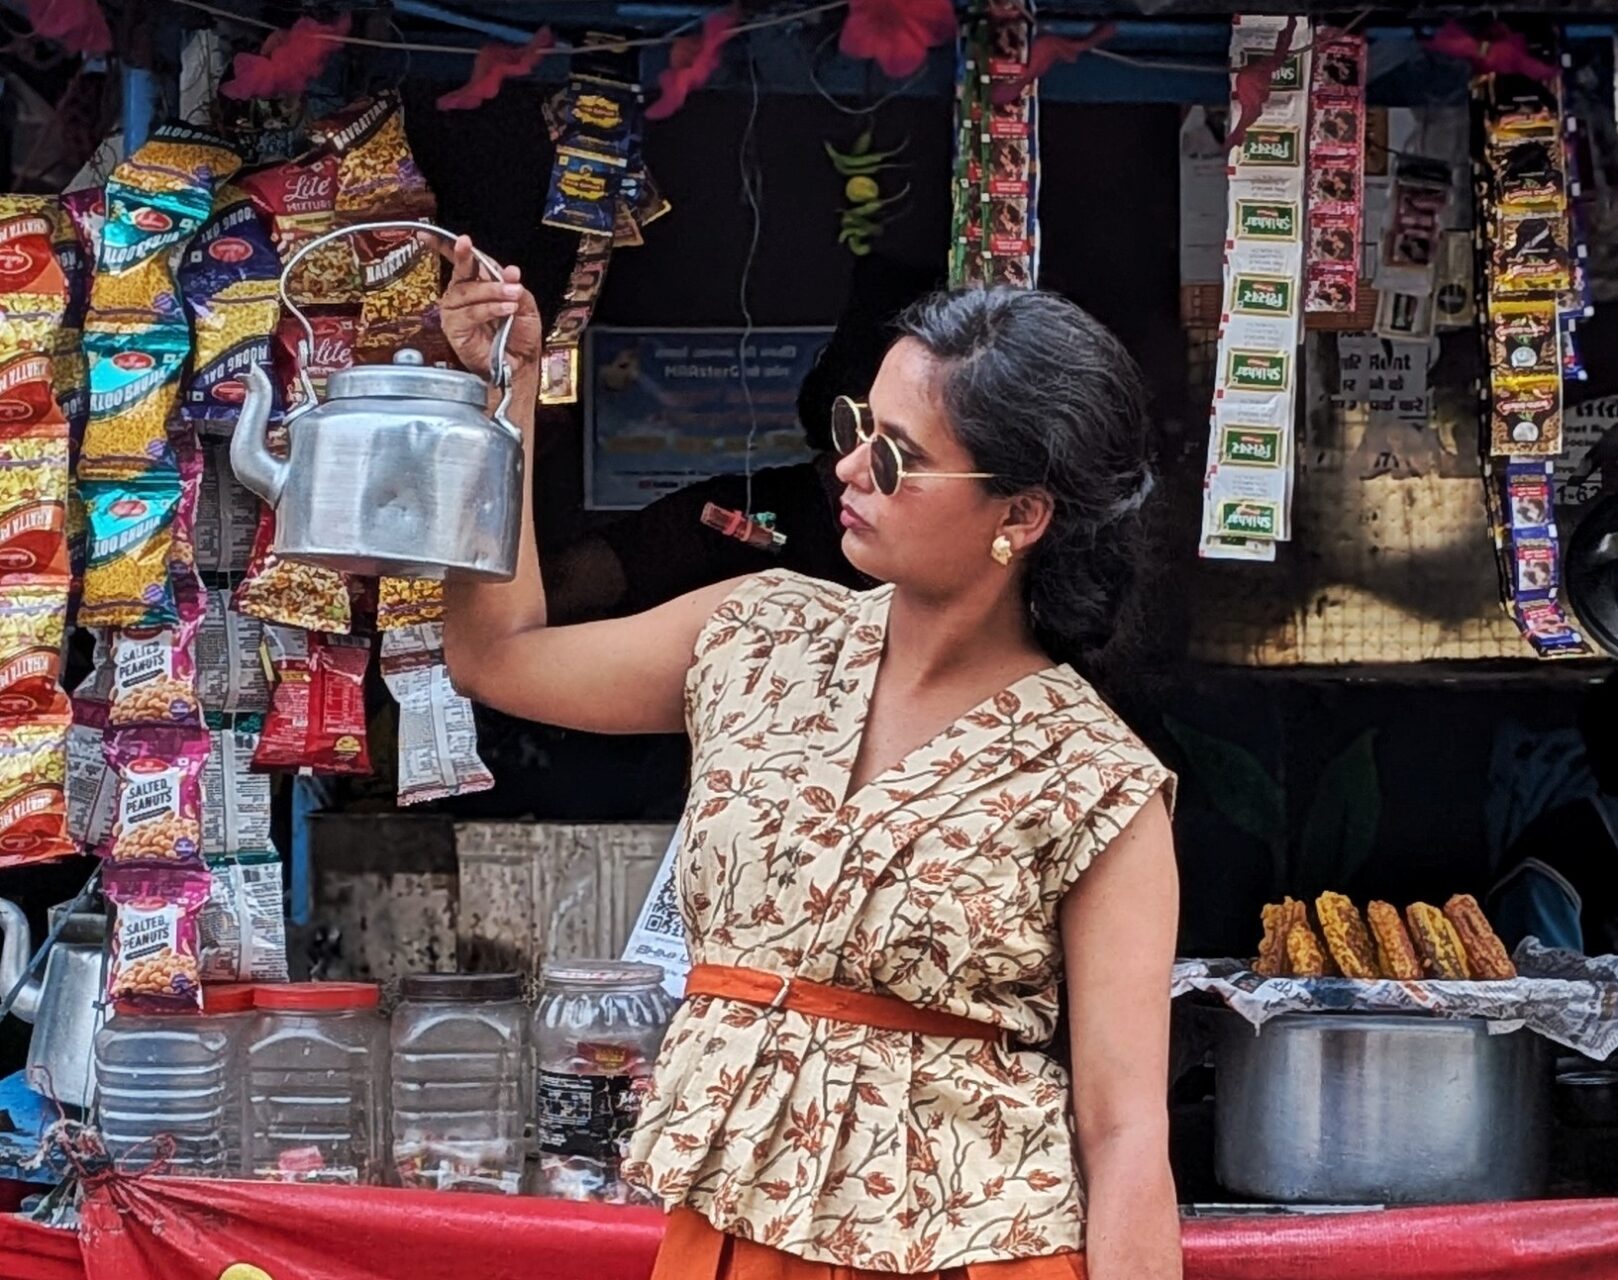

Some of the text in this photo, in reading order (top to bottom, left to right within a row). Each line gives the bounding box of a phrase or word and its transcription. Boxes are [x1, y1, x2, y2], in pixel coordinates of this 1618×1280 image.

[155, 125, 192, 137] ALOO
[223, 206, 257, 230] OONG
[121, 642, 160, 664] SALTED
[119, 655, 165, 679] PEANUTS
[126, 787, 172, 814] PEANUTS
[127, 779, 167, 799] SALTED
[127, 915, 166, 935] SALTED
[124, 926, 170, 950] PEANUTS
